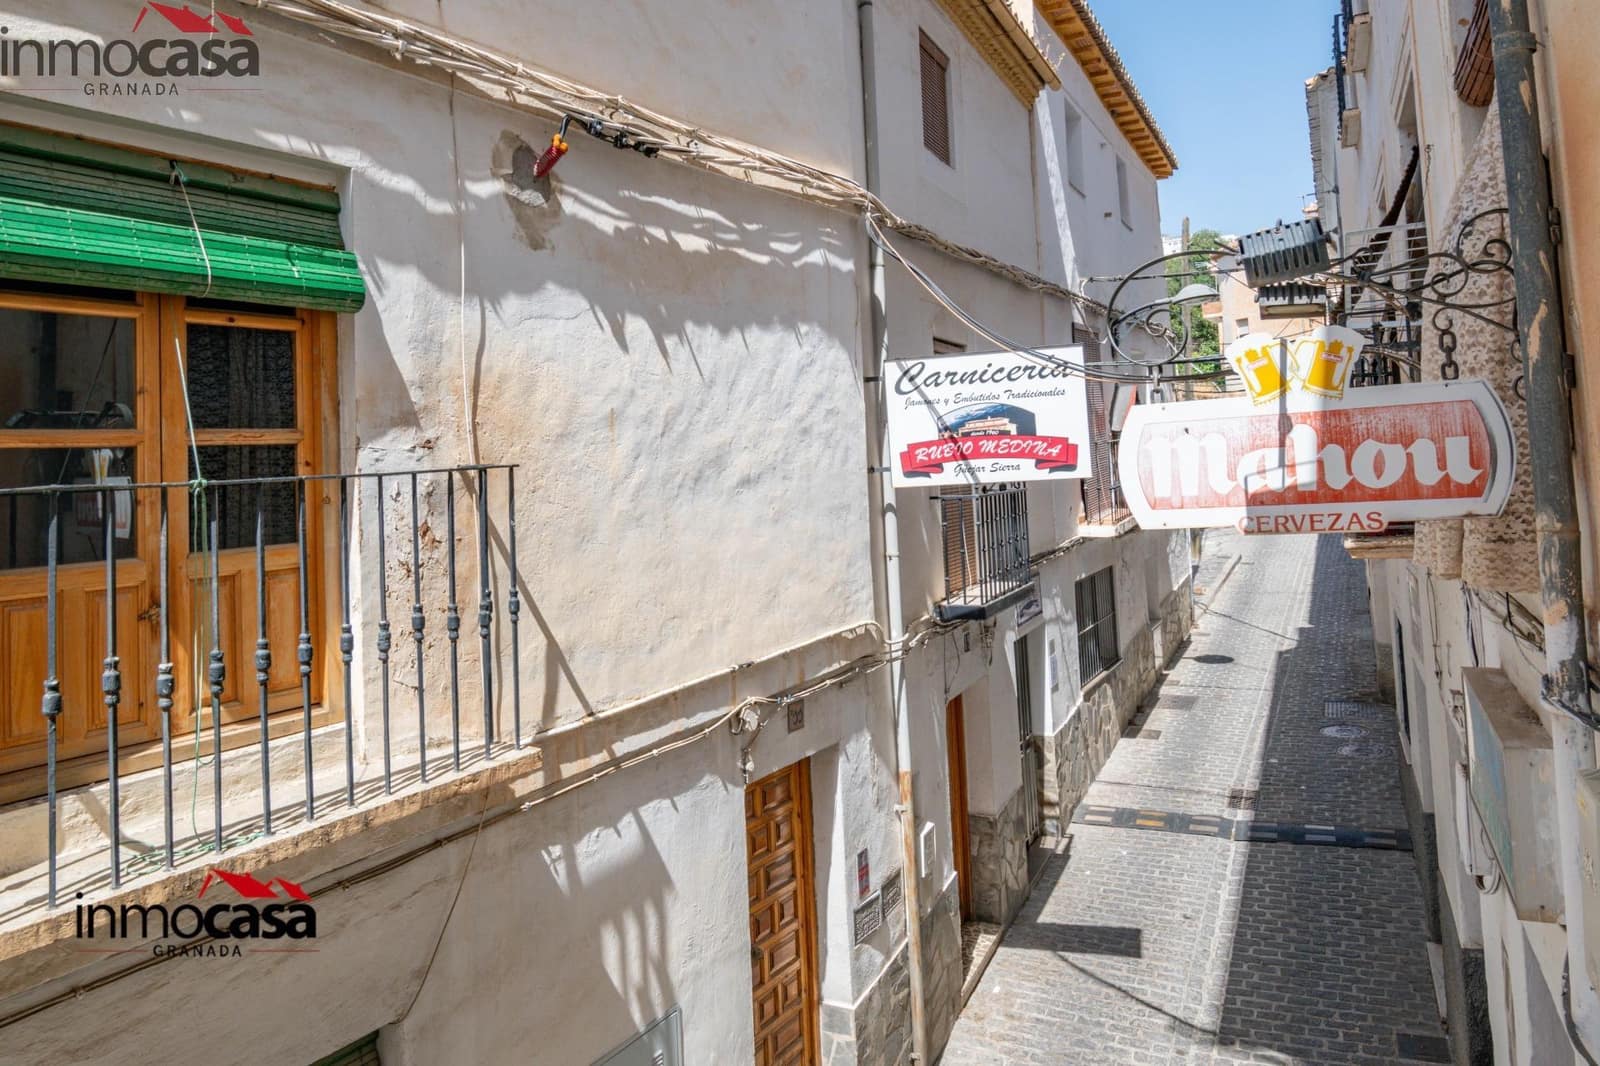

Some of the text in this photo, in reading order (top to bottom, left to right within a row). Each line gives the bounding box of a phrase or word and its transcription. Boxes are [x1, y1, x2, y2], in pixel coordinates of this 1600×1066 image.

[953, 391, 1000, 404] Embutidos
[1003, 388, 1066, 400] Tradicionales
[914, 438, 1062, 464] RUBIO MEDINA
[989, 461, 1021, 473] Sierra
[1239, 511, 1385, 534] CERVEZAS
